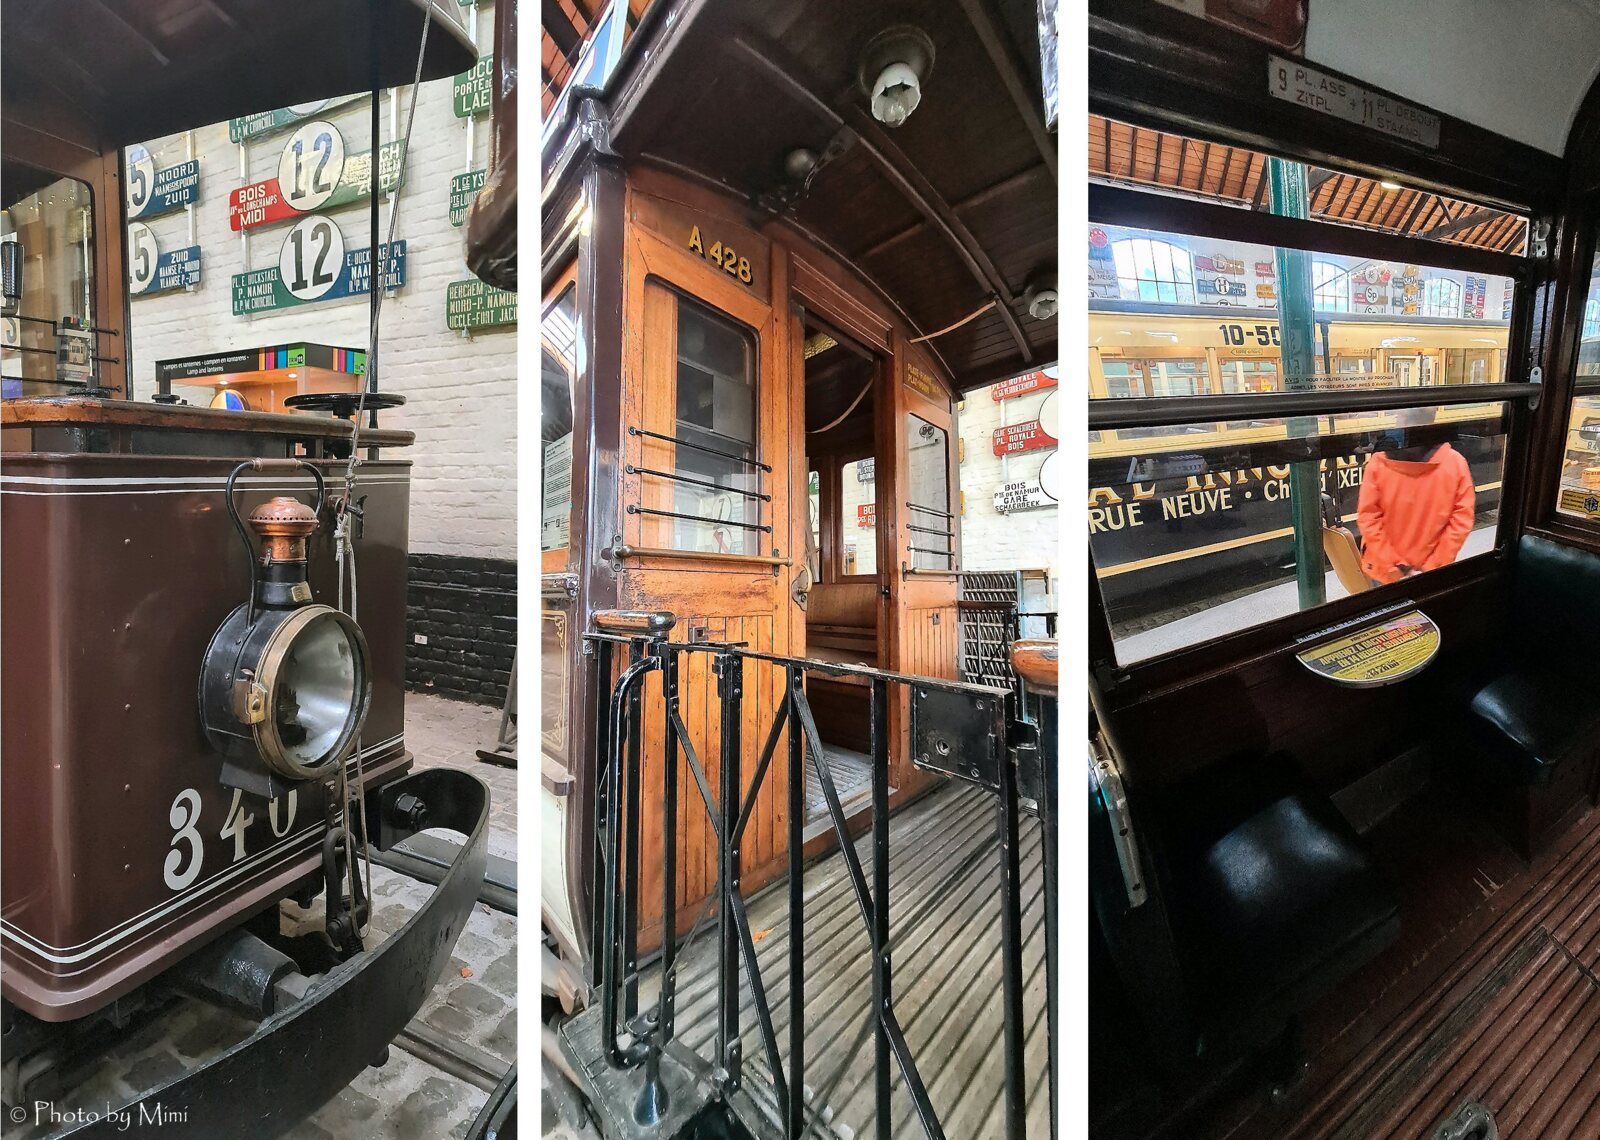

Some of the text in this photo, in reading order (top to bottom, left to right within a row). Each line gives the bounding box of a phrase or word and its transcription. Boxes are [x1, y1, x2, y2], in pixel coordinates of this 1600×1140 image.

[1278, 68, 1287, 92] 9
[158, 162, 195, 184] NOORD
[290, 132, 332, 201] 12
[239, 184, 266, 203] BOIS
[357, 175, 391, 196] ZUD
[164, 188, 190, 206] ZUID
[240, 207, 266, 226] MIDI
[171, 250, 189, 264] ZUID
[290, 222, 333, 291] 12
[688, 224, 753, 286] A 428
[247, 282, 273, 298] NAMUR
[1367, 287, 1377, 300] Sp
[1009, 430, 1036, 442] ROYALE
[1004, 481, 1026, 492] BOIS
[1014, 487, 1040, 496] NAMUR
[1003, 494, 1028, 505] GARE
[1088, 502, 1144, 534] RUE
[1162, 487, 1233, 520] NEUVE
